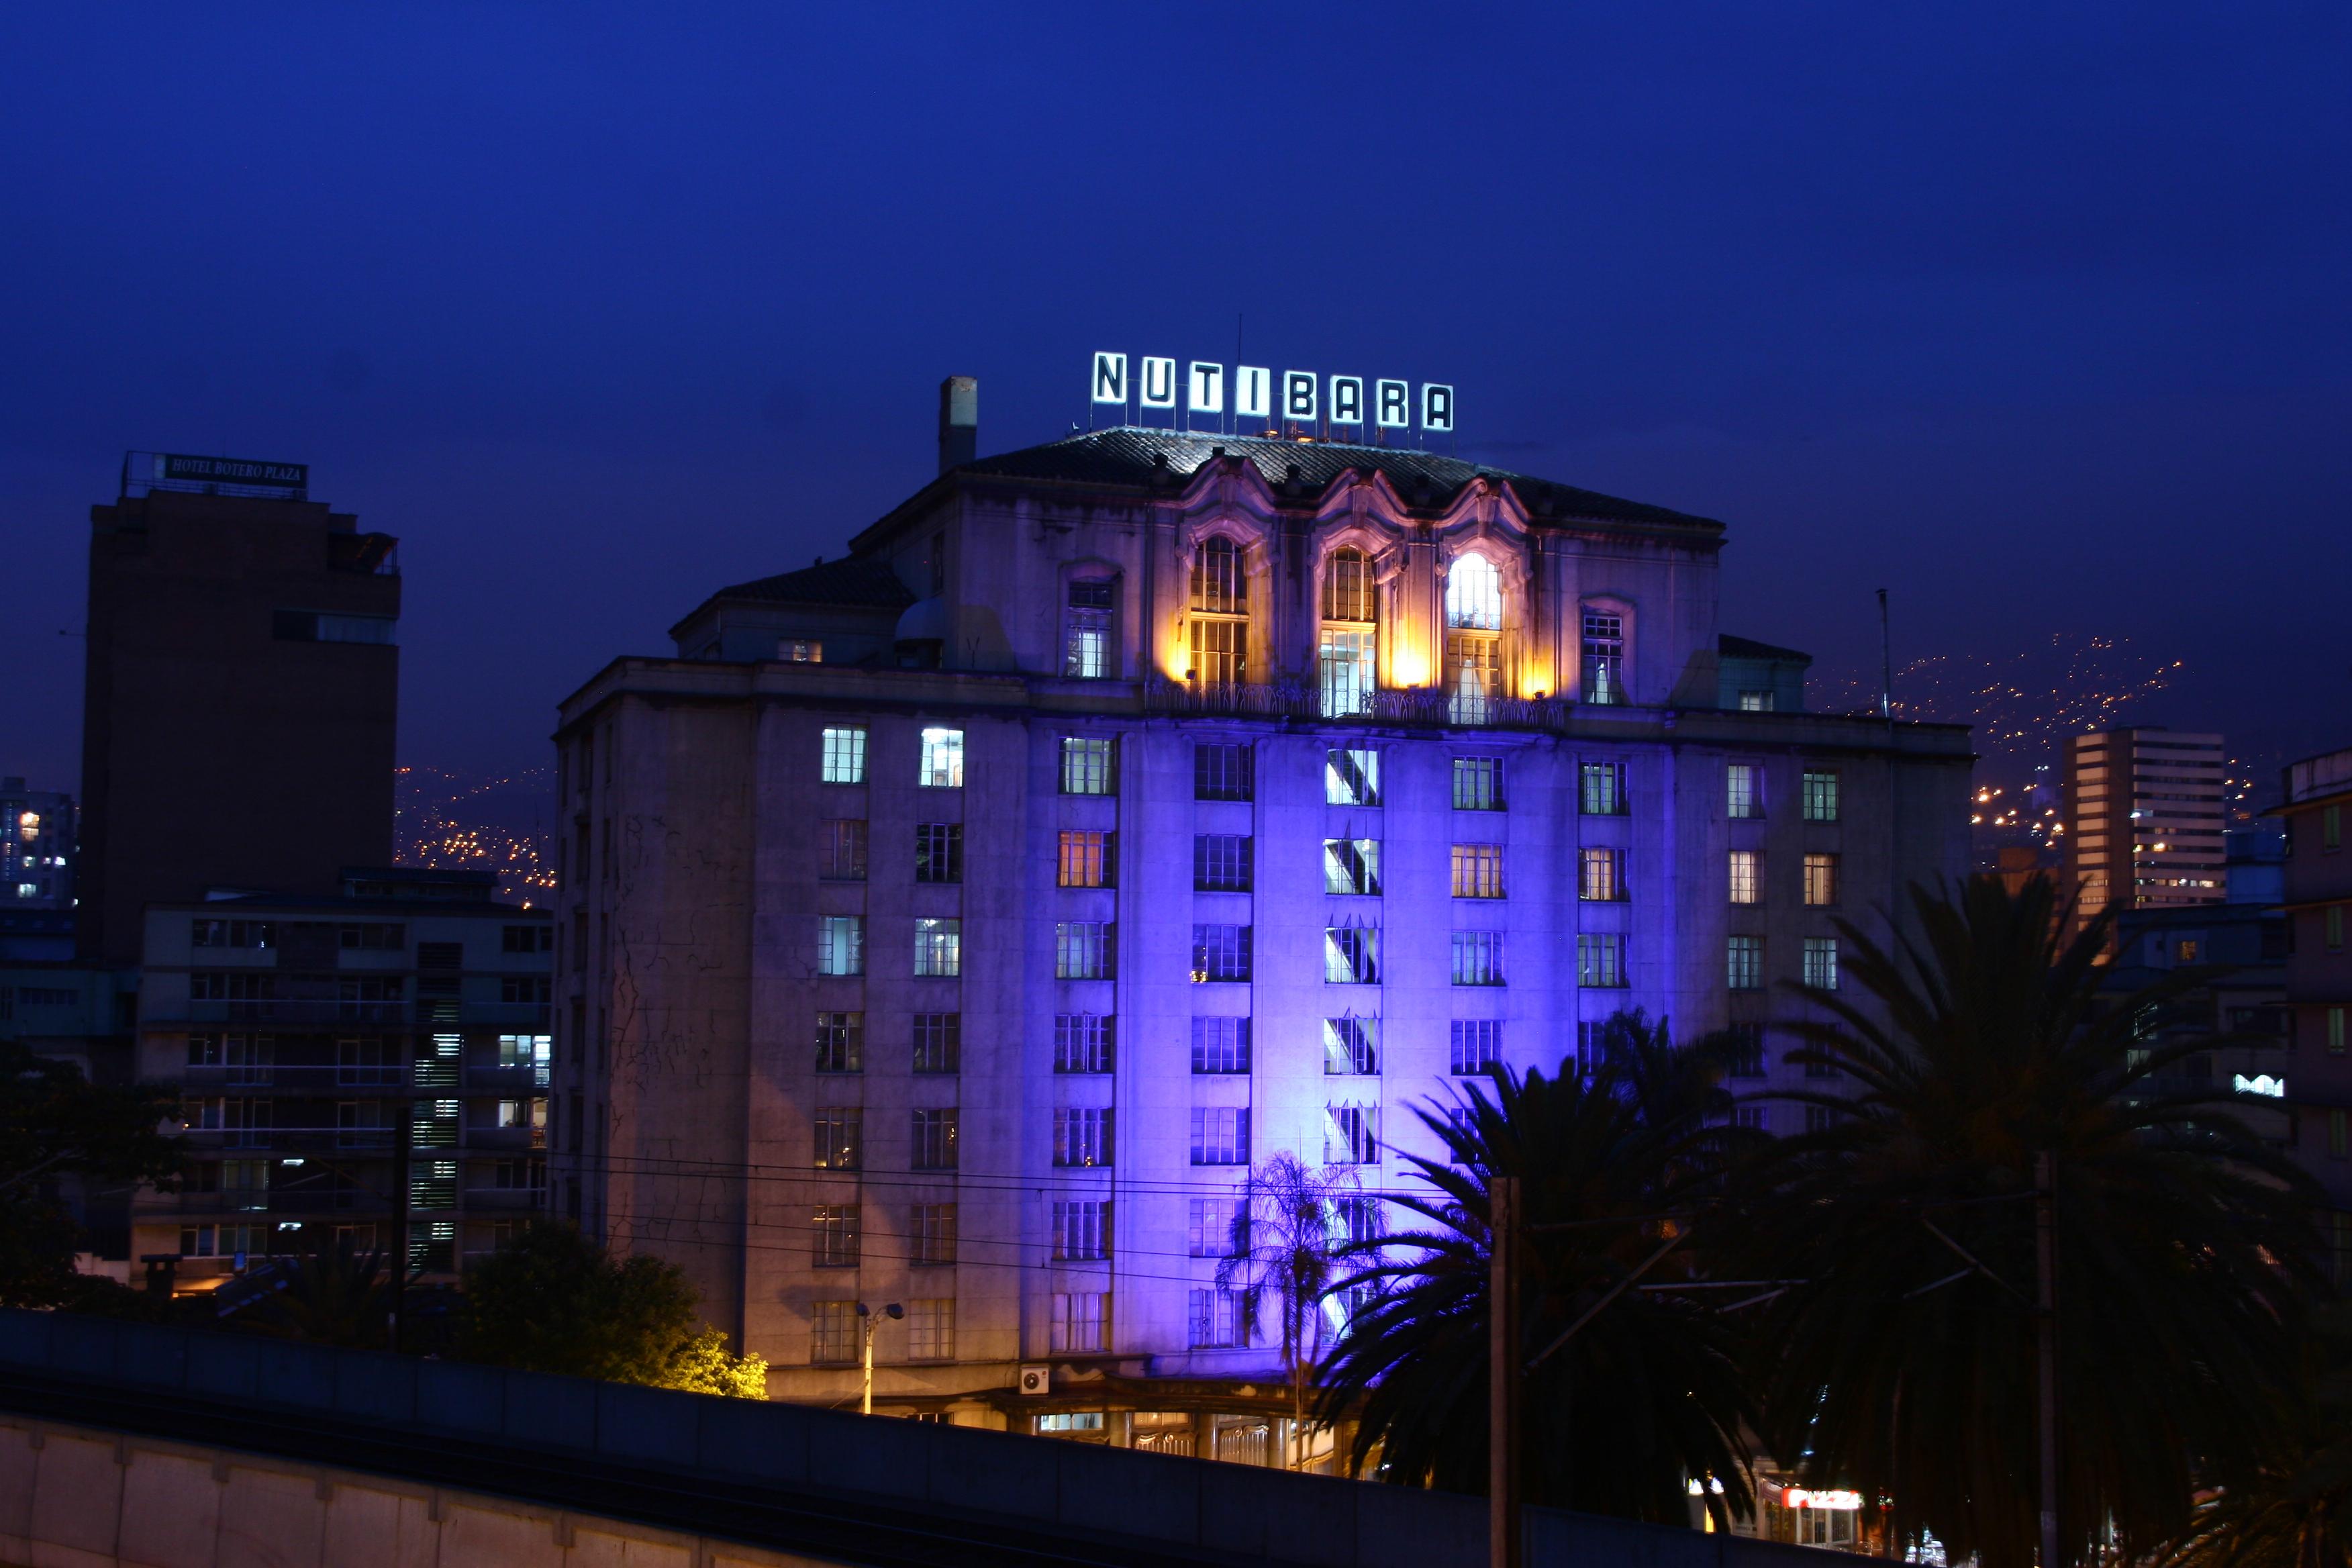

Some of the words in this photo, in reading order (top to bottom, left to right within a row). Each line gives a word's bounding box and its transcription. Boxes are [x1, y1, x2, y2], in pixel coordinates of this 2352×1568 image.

[1097, 354, 1451, 428] NUTIBARA
[172, 458, 211, 474] HOTEL
[215, 461, 261, 479] BOTERO
[262, 465, 301, 481] PLAZA
